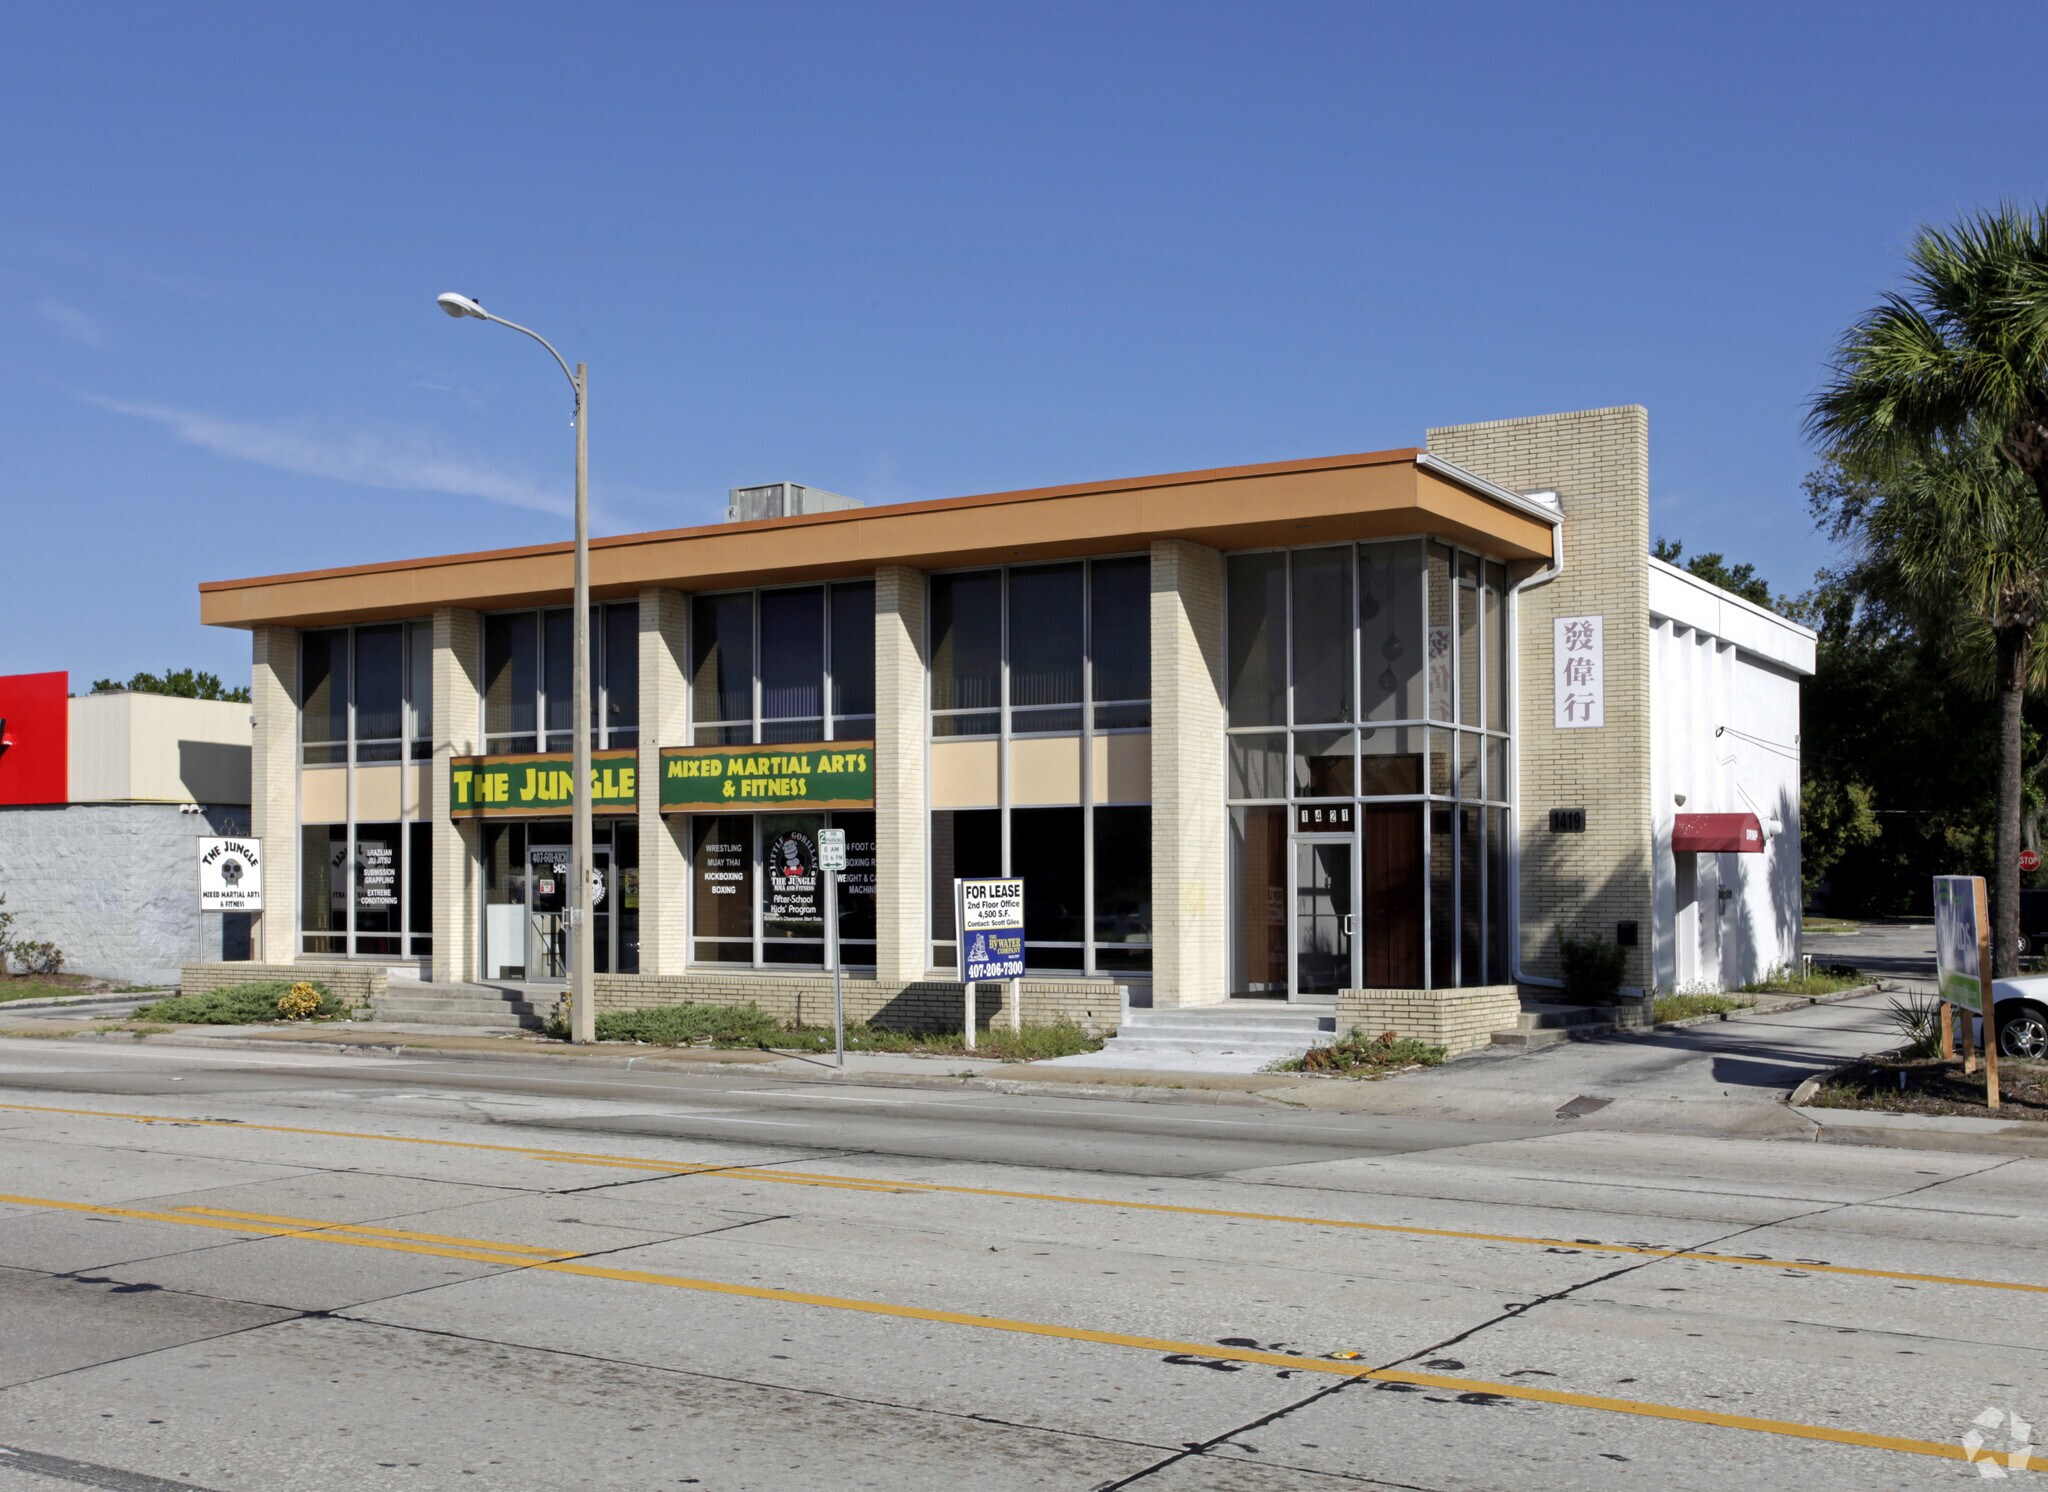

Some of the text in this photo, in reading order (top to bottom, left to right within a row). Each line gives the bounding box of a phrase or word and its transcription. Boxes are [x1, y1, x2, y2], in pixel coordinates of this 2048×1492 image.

[1563, 620, 1595, 721] 發偉行
[668, 754, 866, 778] MIXED MARTIAL ARTS
[453, 771, 509, 803] THE
[722, 778, 806, 797] & FITNESS
[1302, 809, 1348, 822] 1421
[1554, 812, 1580, 829] 1419
[820, 832, 826, 843] 2
[202, 841, 259, 867] THE JUNGLE
[770, 836, 784, 870] LITTLE
[790, 832, 818, 868] GORILLAS
[851, 843, 869, 851] FOOT
[2019, 856, 2039, 865] STOP
[771, 877, 816, 885] THE JUNGLE
[837, 874, 862, 882] WEIGHT
[864, 874, 868, 882] &
[773, 894, 813, 903] After-School
[966, 884, 1020, 899] FOR LEASE
[771, 904, 816, 916] Kids' Program
[978, 910, 1010, 919] 4,500 S.F.
[968, 961, 1023, 978] 407-206-7300
